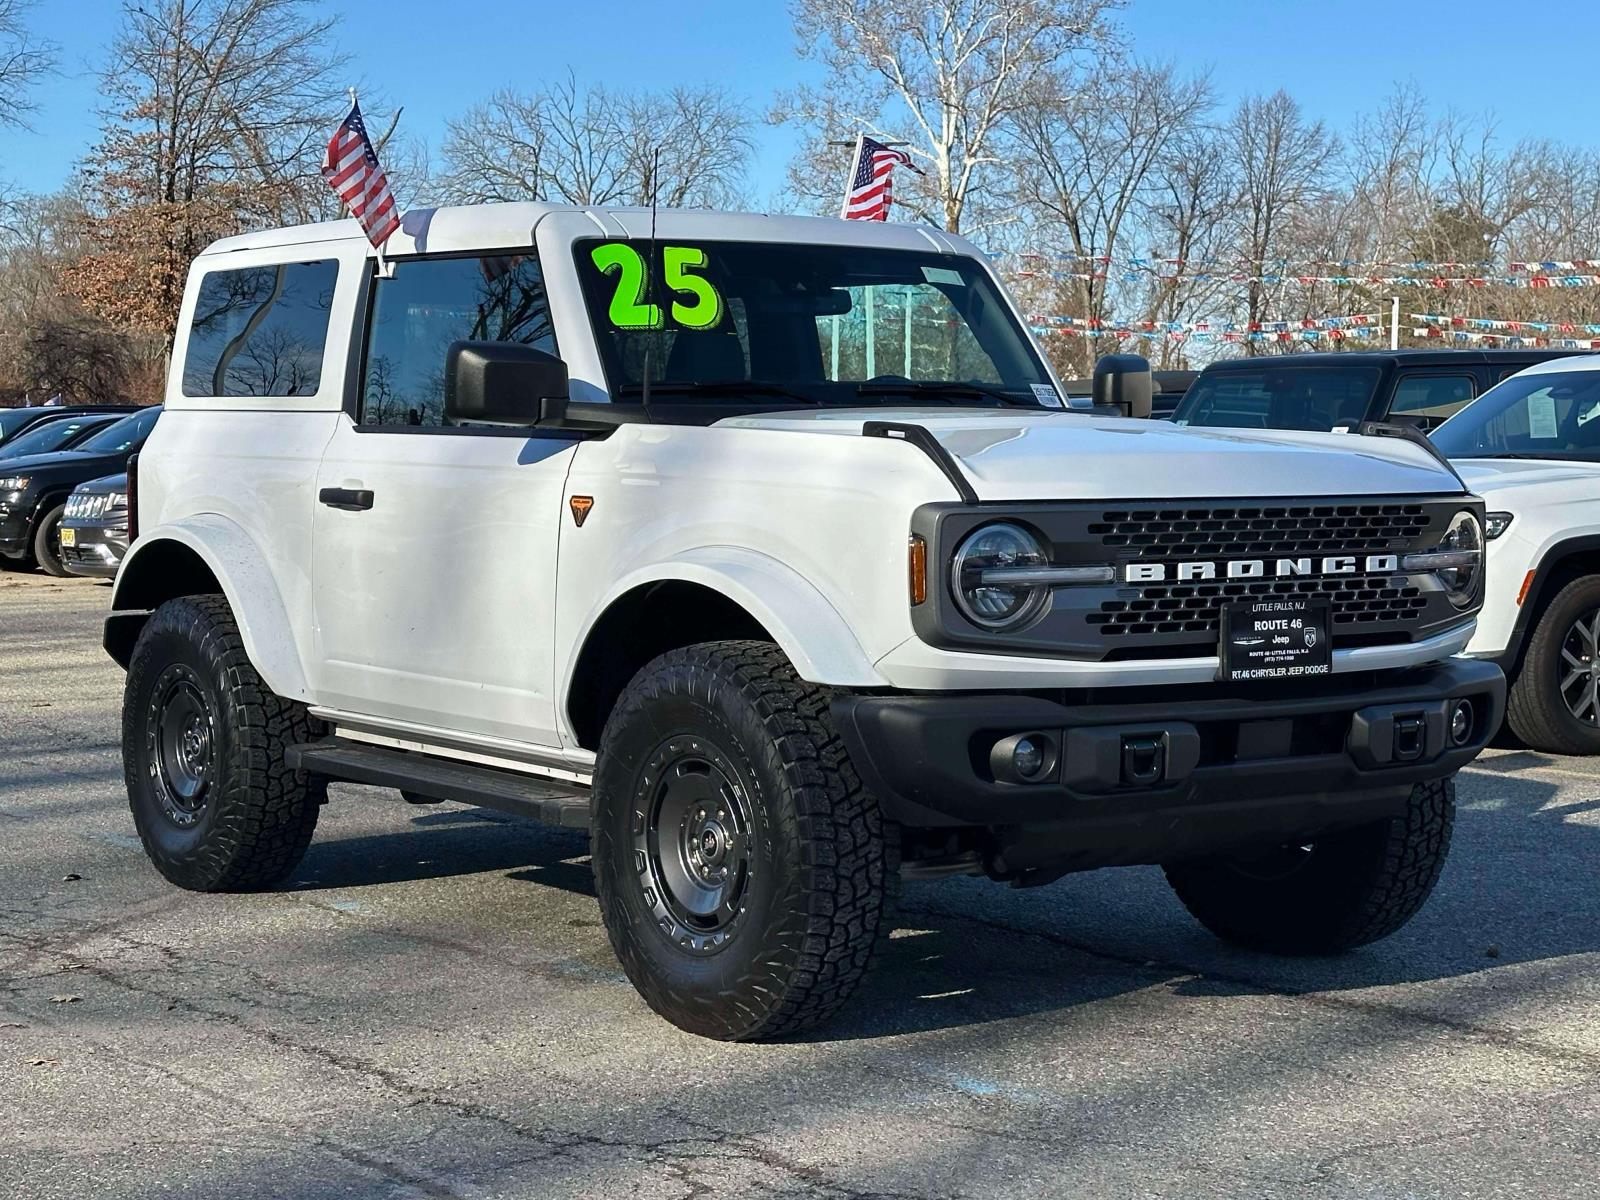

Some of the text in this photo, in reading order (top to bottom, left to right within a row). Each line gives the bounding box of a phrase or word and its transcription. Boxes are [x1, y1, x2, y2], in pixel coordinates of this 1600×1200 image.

[591, 243, 723, 330] 25
[1125, 554, 1398, 583] BRONCO
[1252, 603, 1273, 612] LITTLE
[1273, 602, 1294, 611] FALLS,
[1254, 619, 1302, 631] ROUTE 46
[1272, 635, 1290, 645] Jeep
[1250, 667, 1287, 678] CHRYSLER
[1287, 666, 1304, 675] JEEP
[1305, 664, 1329, 674] DODGE
